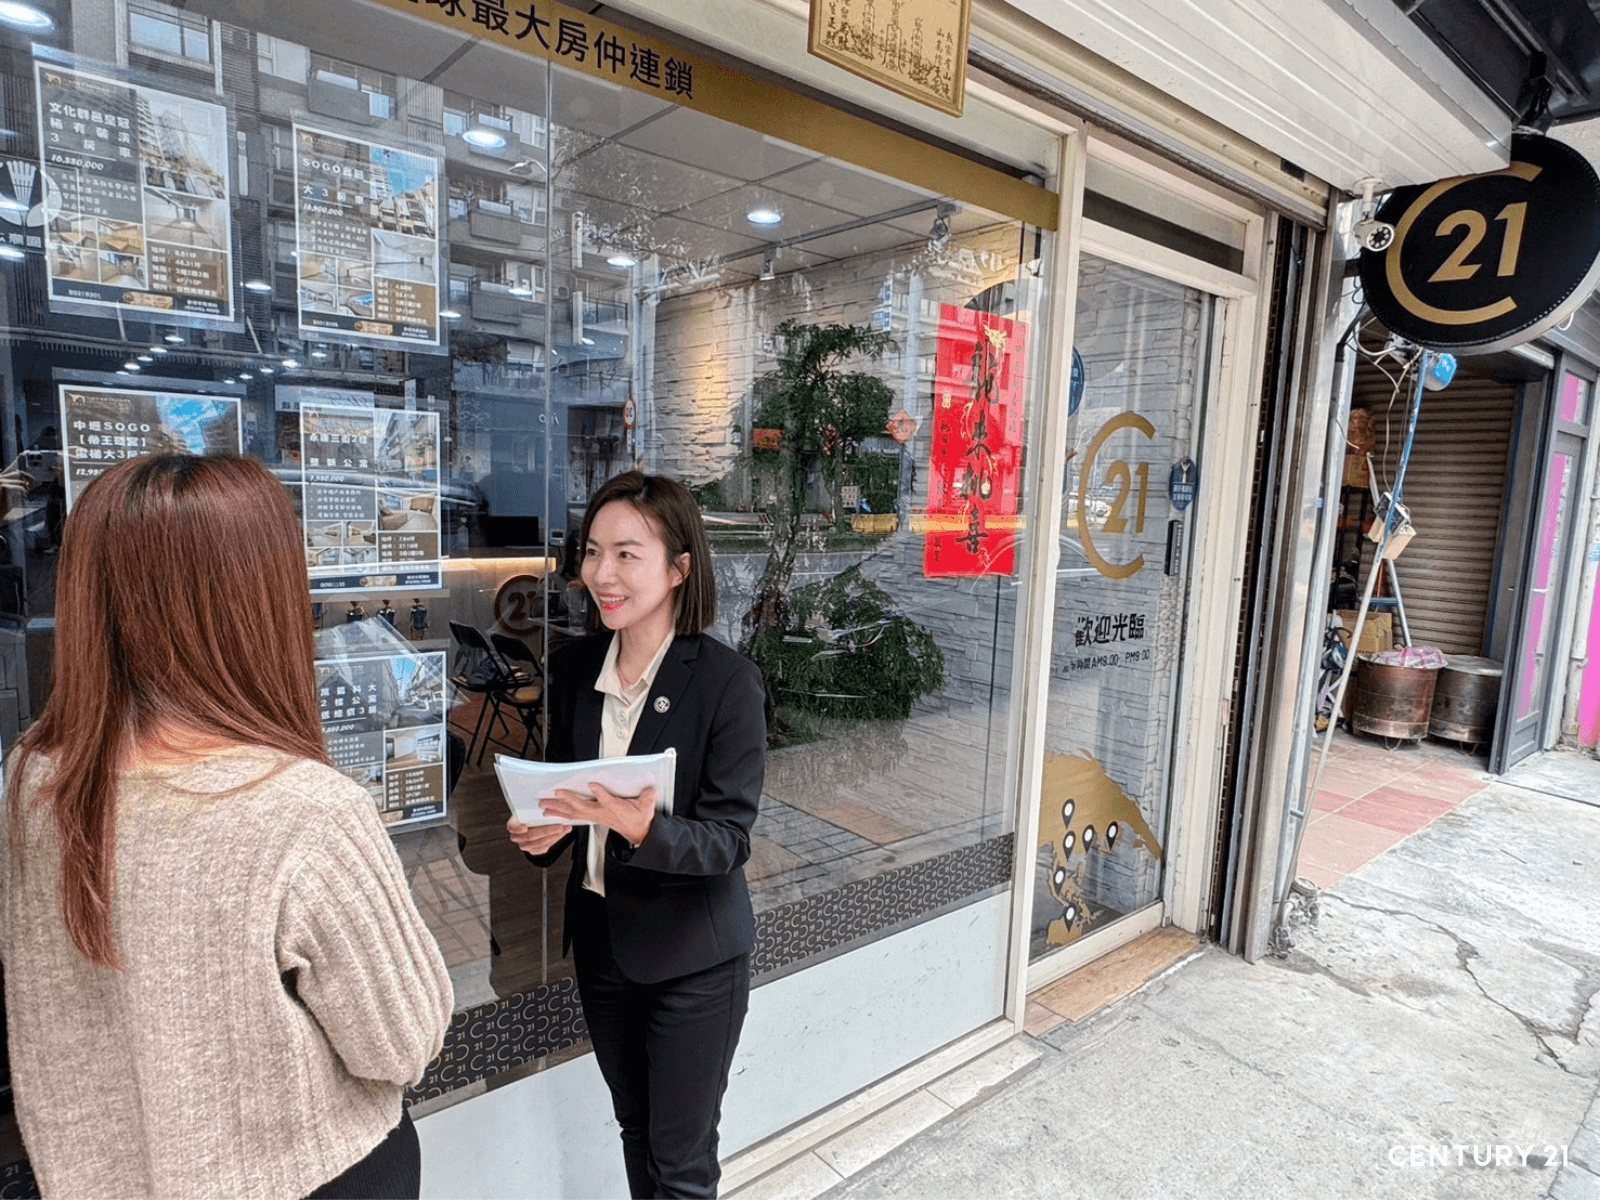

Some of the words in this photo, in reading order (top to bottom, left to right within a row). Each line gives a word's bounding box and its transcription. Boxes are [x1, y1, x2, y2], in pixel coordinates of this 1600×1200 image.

[1427, 201, 1528, 283] 21
[76, 449, 151, 461] 電梯大3房
[1101, 459, 1149, 534] 21
[1075, 613, 1145, 648] 歡迎光臨
